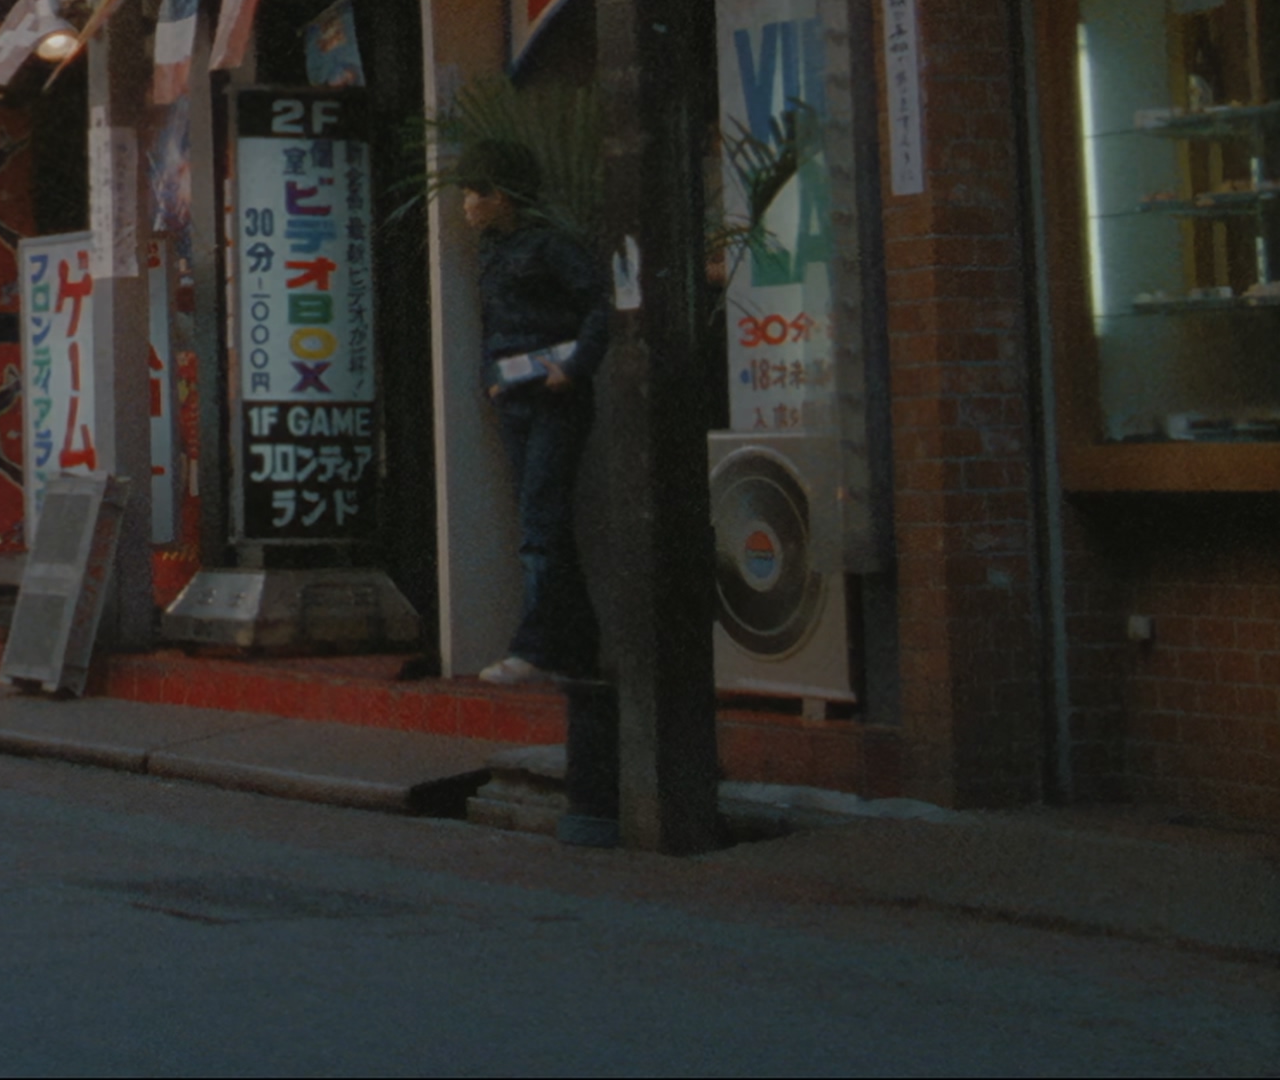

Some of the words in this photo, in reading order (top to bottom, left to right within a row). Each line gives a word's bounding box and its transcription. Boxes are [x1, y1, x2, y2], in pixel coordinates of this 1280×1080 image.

[271, 99, 340, 135] 2F
[55, 250, 97, 471] ゲーム
[248, 405, 279, 437] 1F
[286, 405, 371, 437] GAME
[249, 443, 372, 483] フロンティア
[271, 489, 359, 528] ランド
